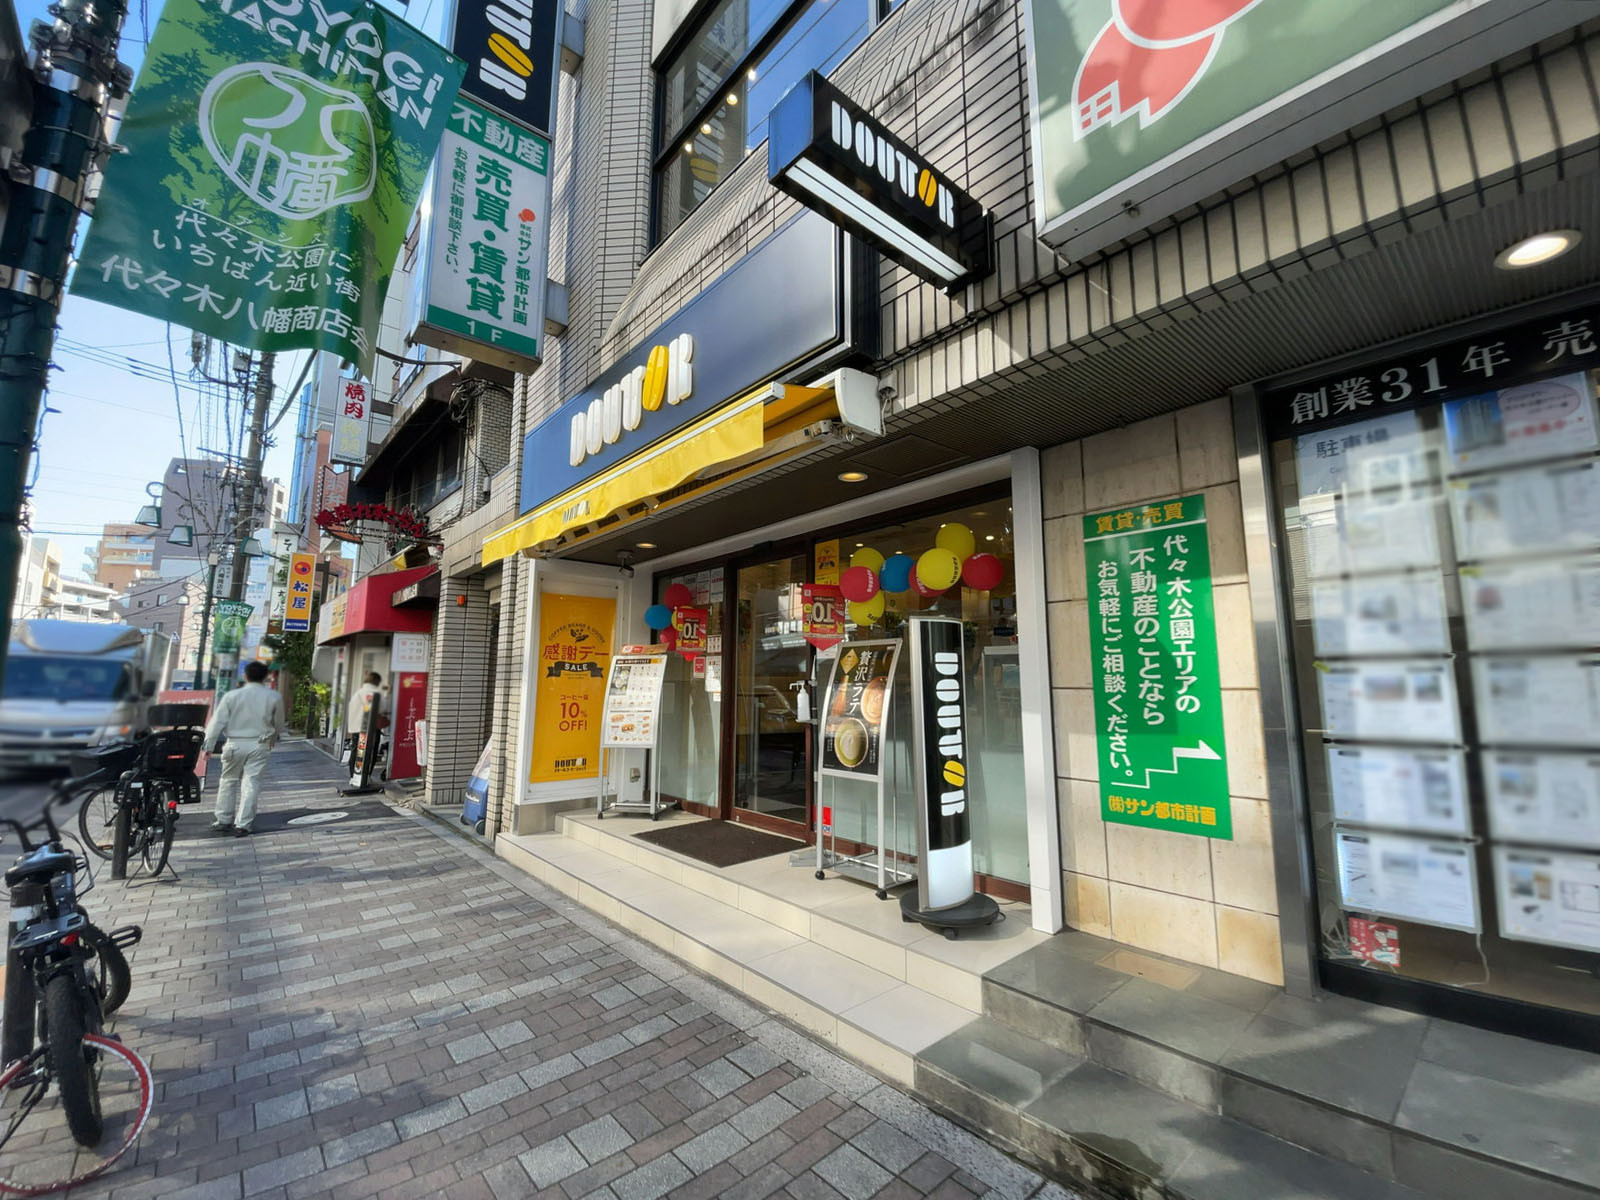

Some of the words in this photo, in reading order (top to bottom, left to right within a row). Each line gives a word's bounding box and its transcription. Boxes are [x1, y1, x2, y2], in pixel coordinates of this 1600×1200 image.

[450, 101, 545, 170] 不動産
[831, 100, 954, 228] DOUTOR
[152, 229, 361, 303] いちばん近い街
[175, 210, 353, 273] 代々木公園に
[466, 154, 513, 320] 売買・賃貸
[100, 254, 370, 358] 代々木八幡商店会
[344, 381, 366, 419] 焼肉
[569, 333, 694, 467] DOUTOR
[293, 580, 309, 608] 松屋
[1130, 547, 1165, 726] 不動産のことなら
[1163, 535, 1201, 714] 代々木公園エリアの
[543, 643, 610, 661] 感謝デー
[564, 663, 588, 671] SALE
[1097, 560, 1134, 778] お気軽にご相談ください。
[559, 720, 588, 732] OFF!
[934, 652, 966, 817] DOUTOR
